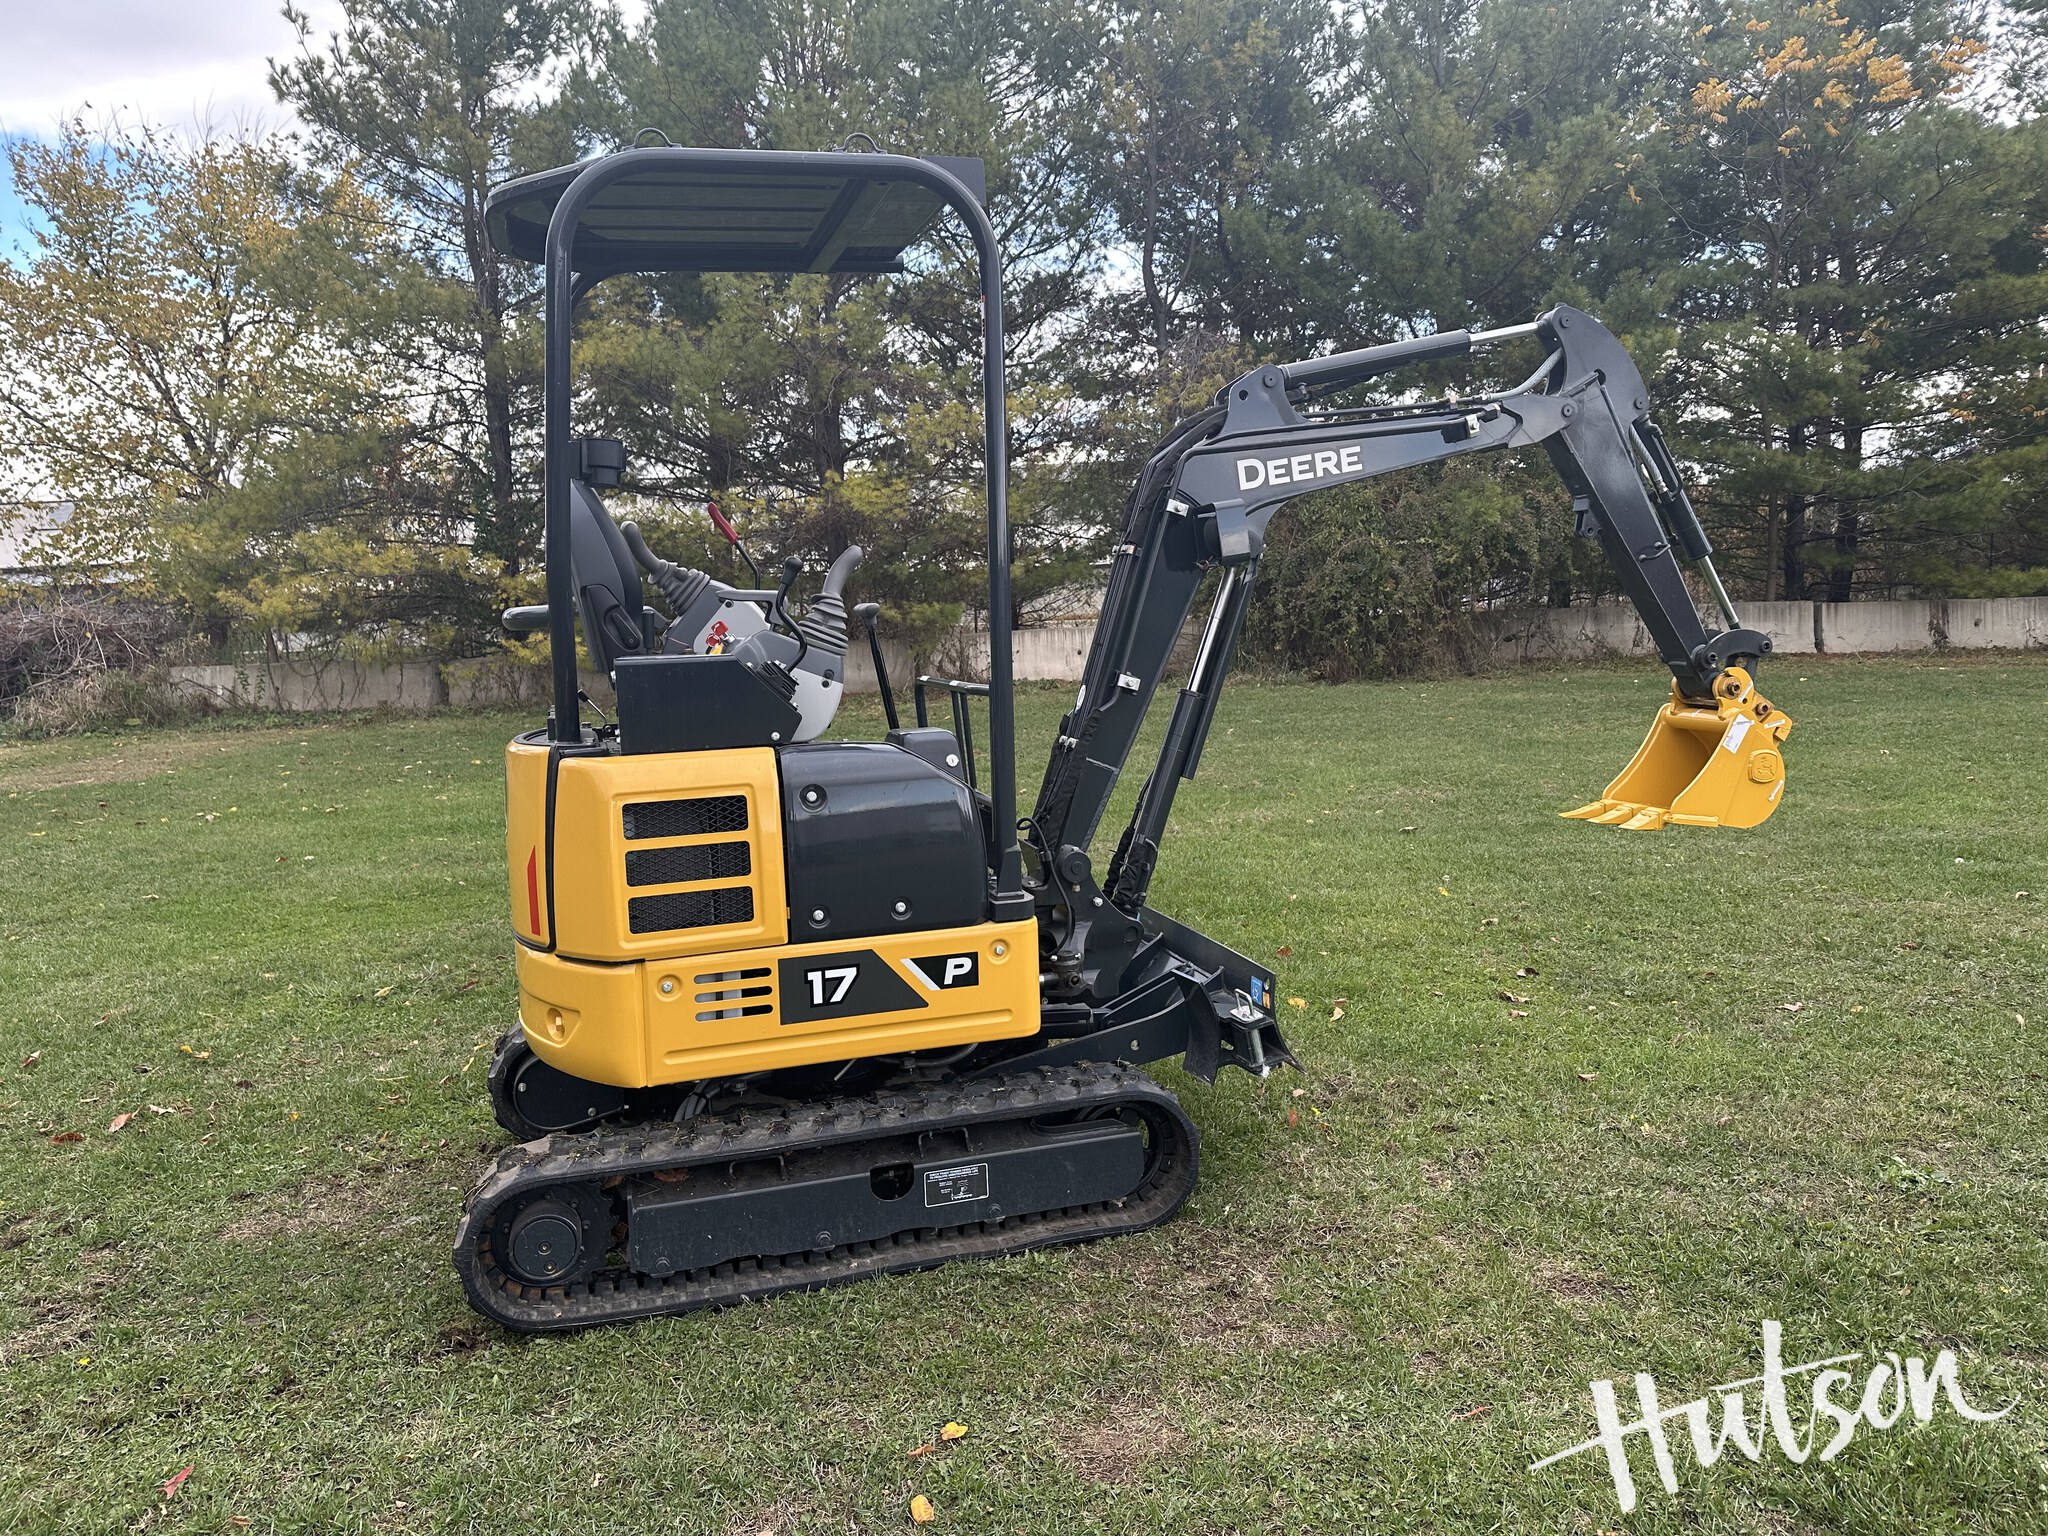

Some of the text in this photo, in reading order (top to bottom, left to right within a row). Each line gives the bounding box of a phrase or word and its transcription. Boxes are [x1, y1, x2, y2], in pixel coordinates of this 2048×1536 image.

[1236, 445, 1363, 491] DEERE
[807, 956, 973, 1005] 17 P
